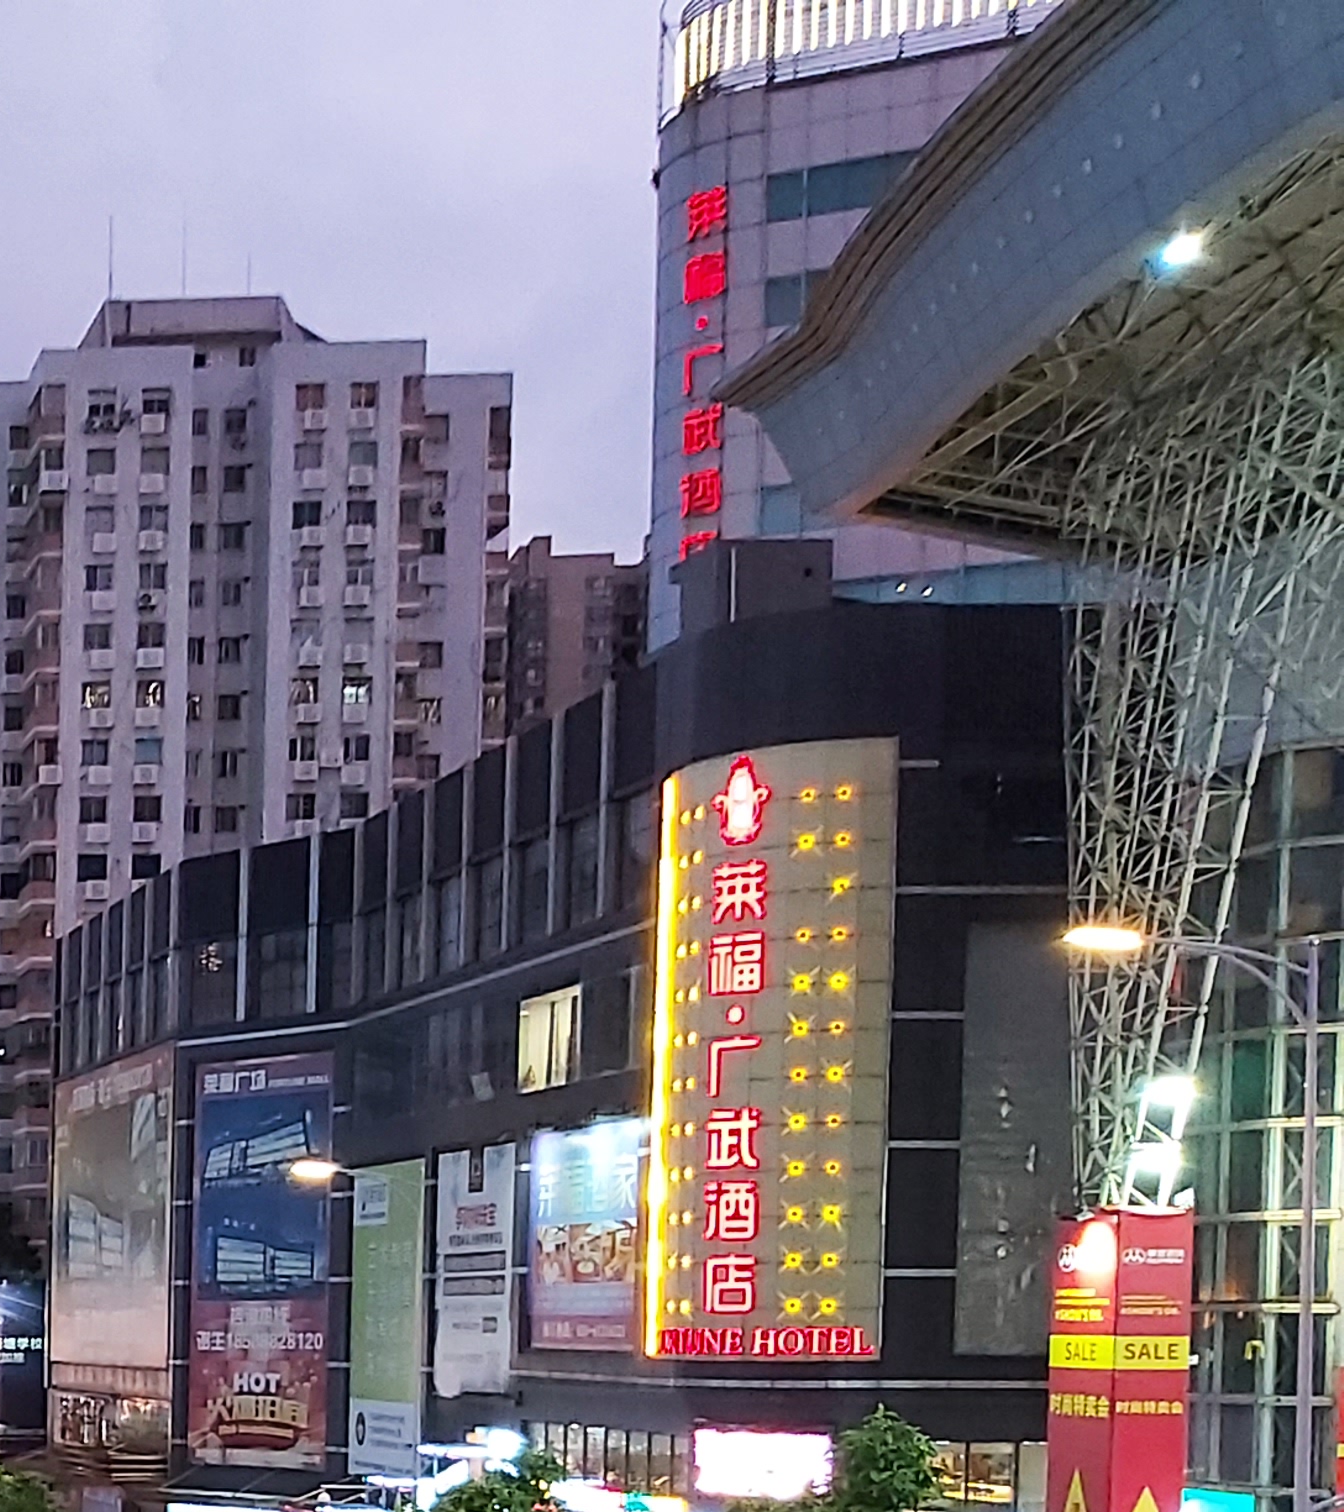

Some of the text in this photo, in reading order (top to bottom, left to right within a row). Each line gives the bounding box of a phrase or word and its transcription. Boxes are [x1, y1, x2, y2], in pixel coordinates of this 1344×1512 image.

[702, 860, 768, 1316] 莱福·广武酒店
[751, 1326, 875, 1356] HOTEL
[1064, 1341, 1098, 1362] SALE
[1123, 1342, 1180, 1361] SALE
[232, 1372, 282, 1394] HOT
